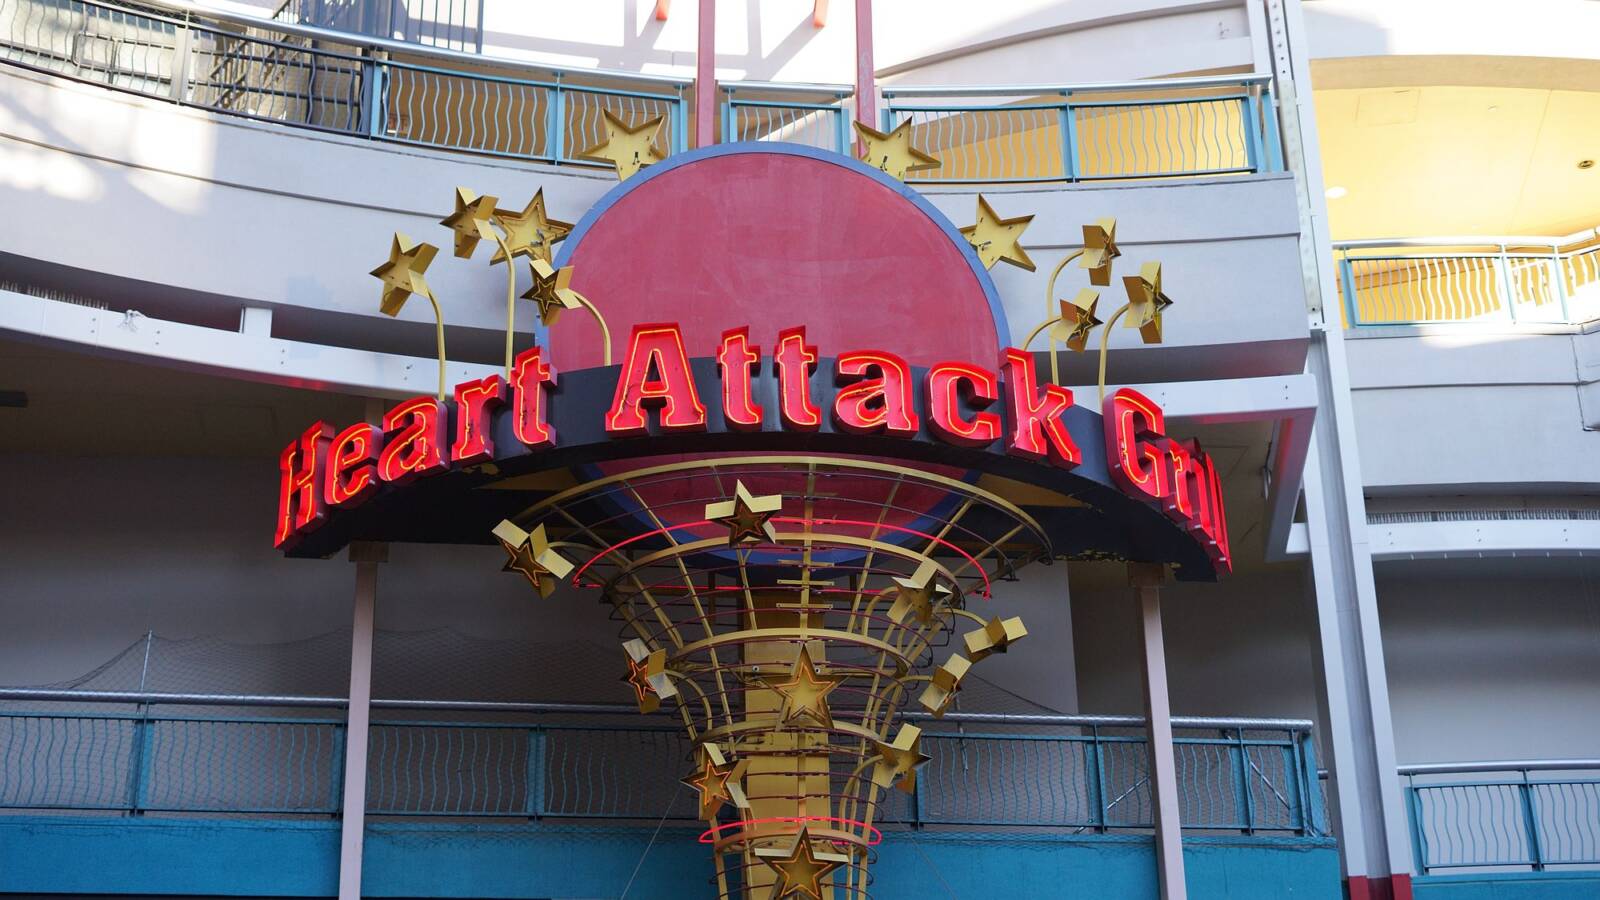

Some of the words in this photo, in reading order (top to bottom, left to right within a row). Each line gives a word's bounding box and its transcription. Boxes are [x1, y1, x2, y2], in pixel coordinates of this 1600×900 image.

[274, 346, 558, 549] Heart
[605, 323, 1081, 468] Attack
[1104, 387, 1233, 575] Grill
